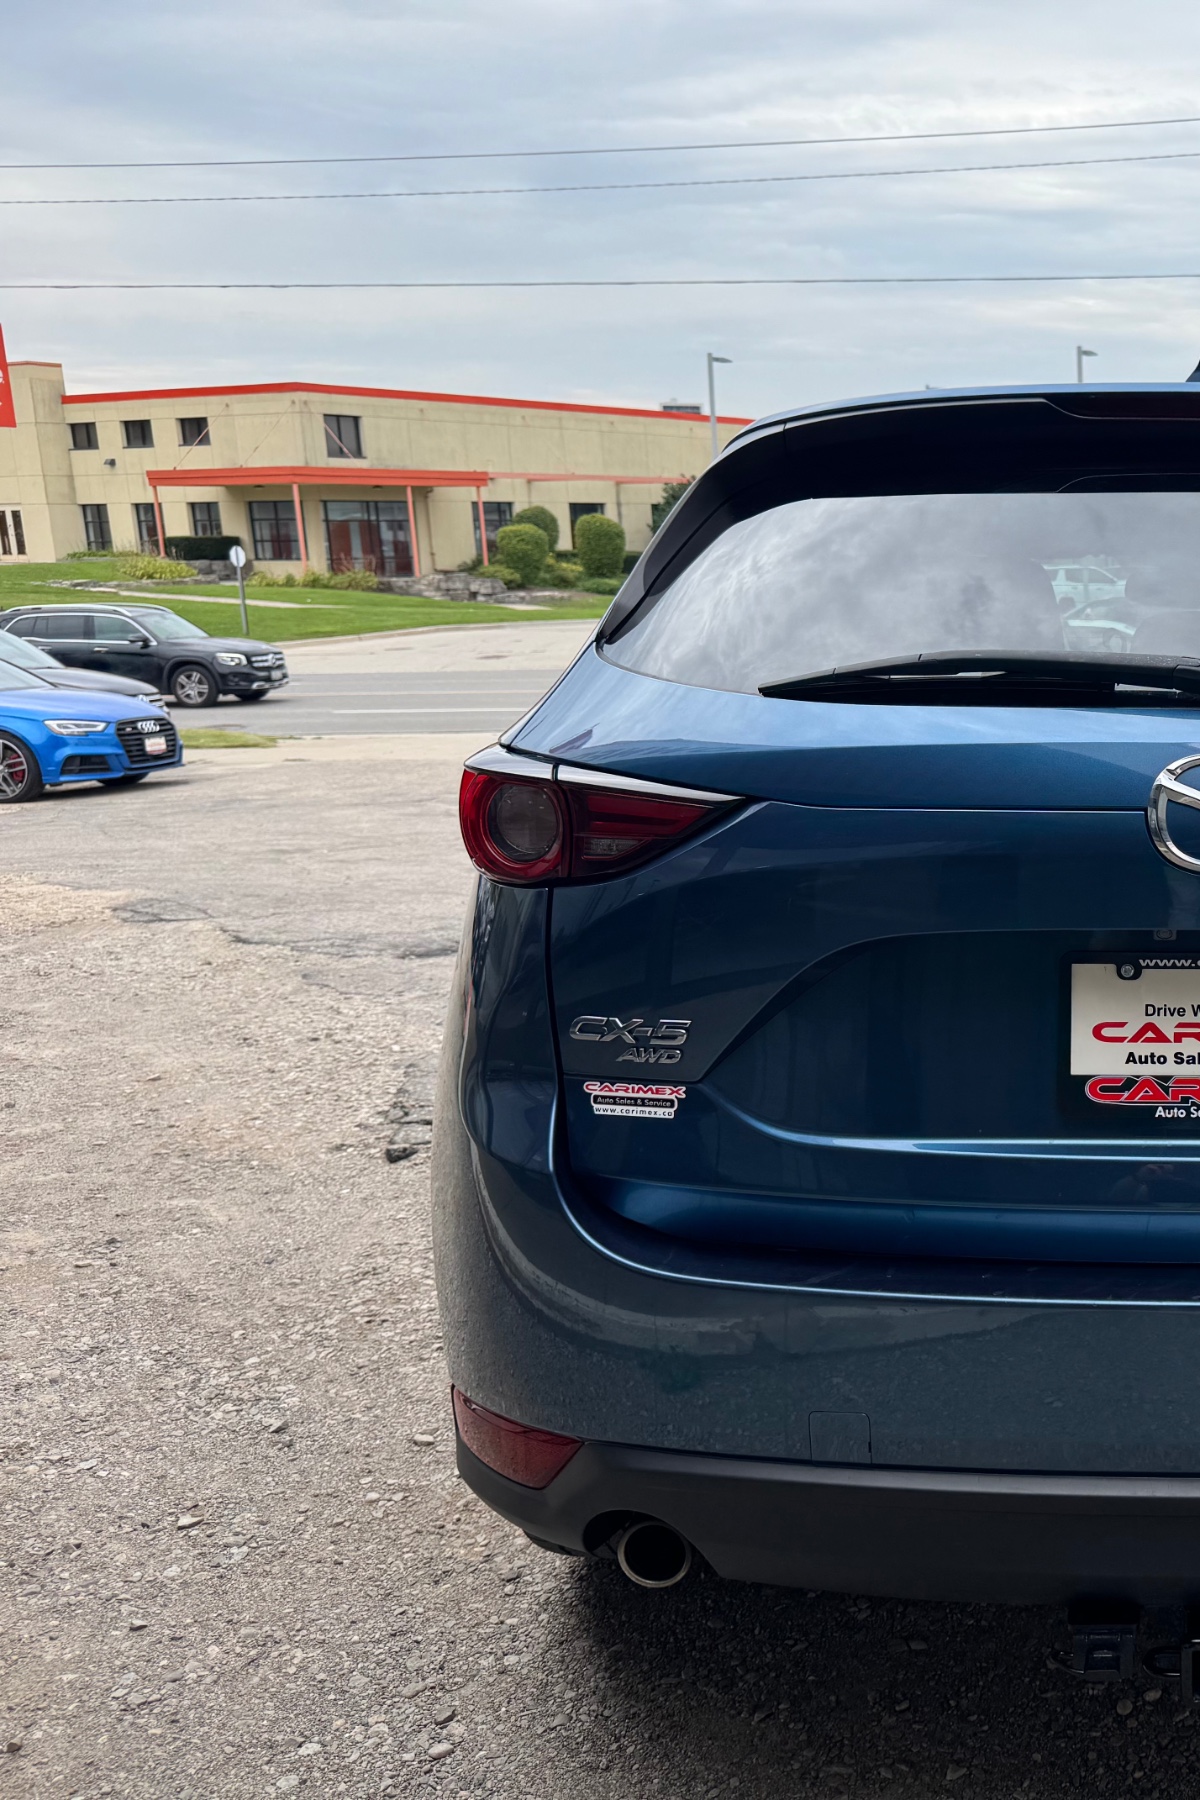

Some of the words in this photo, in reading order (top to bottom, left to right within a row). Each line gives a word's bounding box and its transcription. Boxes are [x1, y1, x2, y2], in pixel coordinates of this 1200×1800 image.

[1144, 1003, 1187, 1017] Drive
[569, 1015, 692, 1045] CX-5
[616, 1048, 682, 1064] AWD
[1125, 1051, 1168, 1065] Auto
[585, 1083, 685, 1096] CARIMEX
[616, 1097, 635, 1105] Sales
[645, 1098, 671, 1107] Service
[595, 1106, 673, 1116] www.carimex.ca
[1154, 1106, 1187, 1119] Auto
